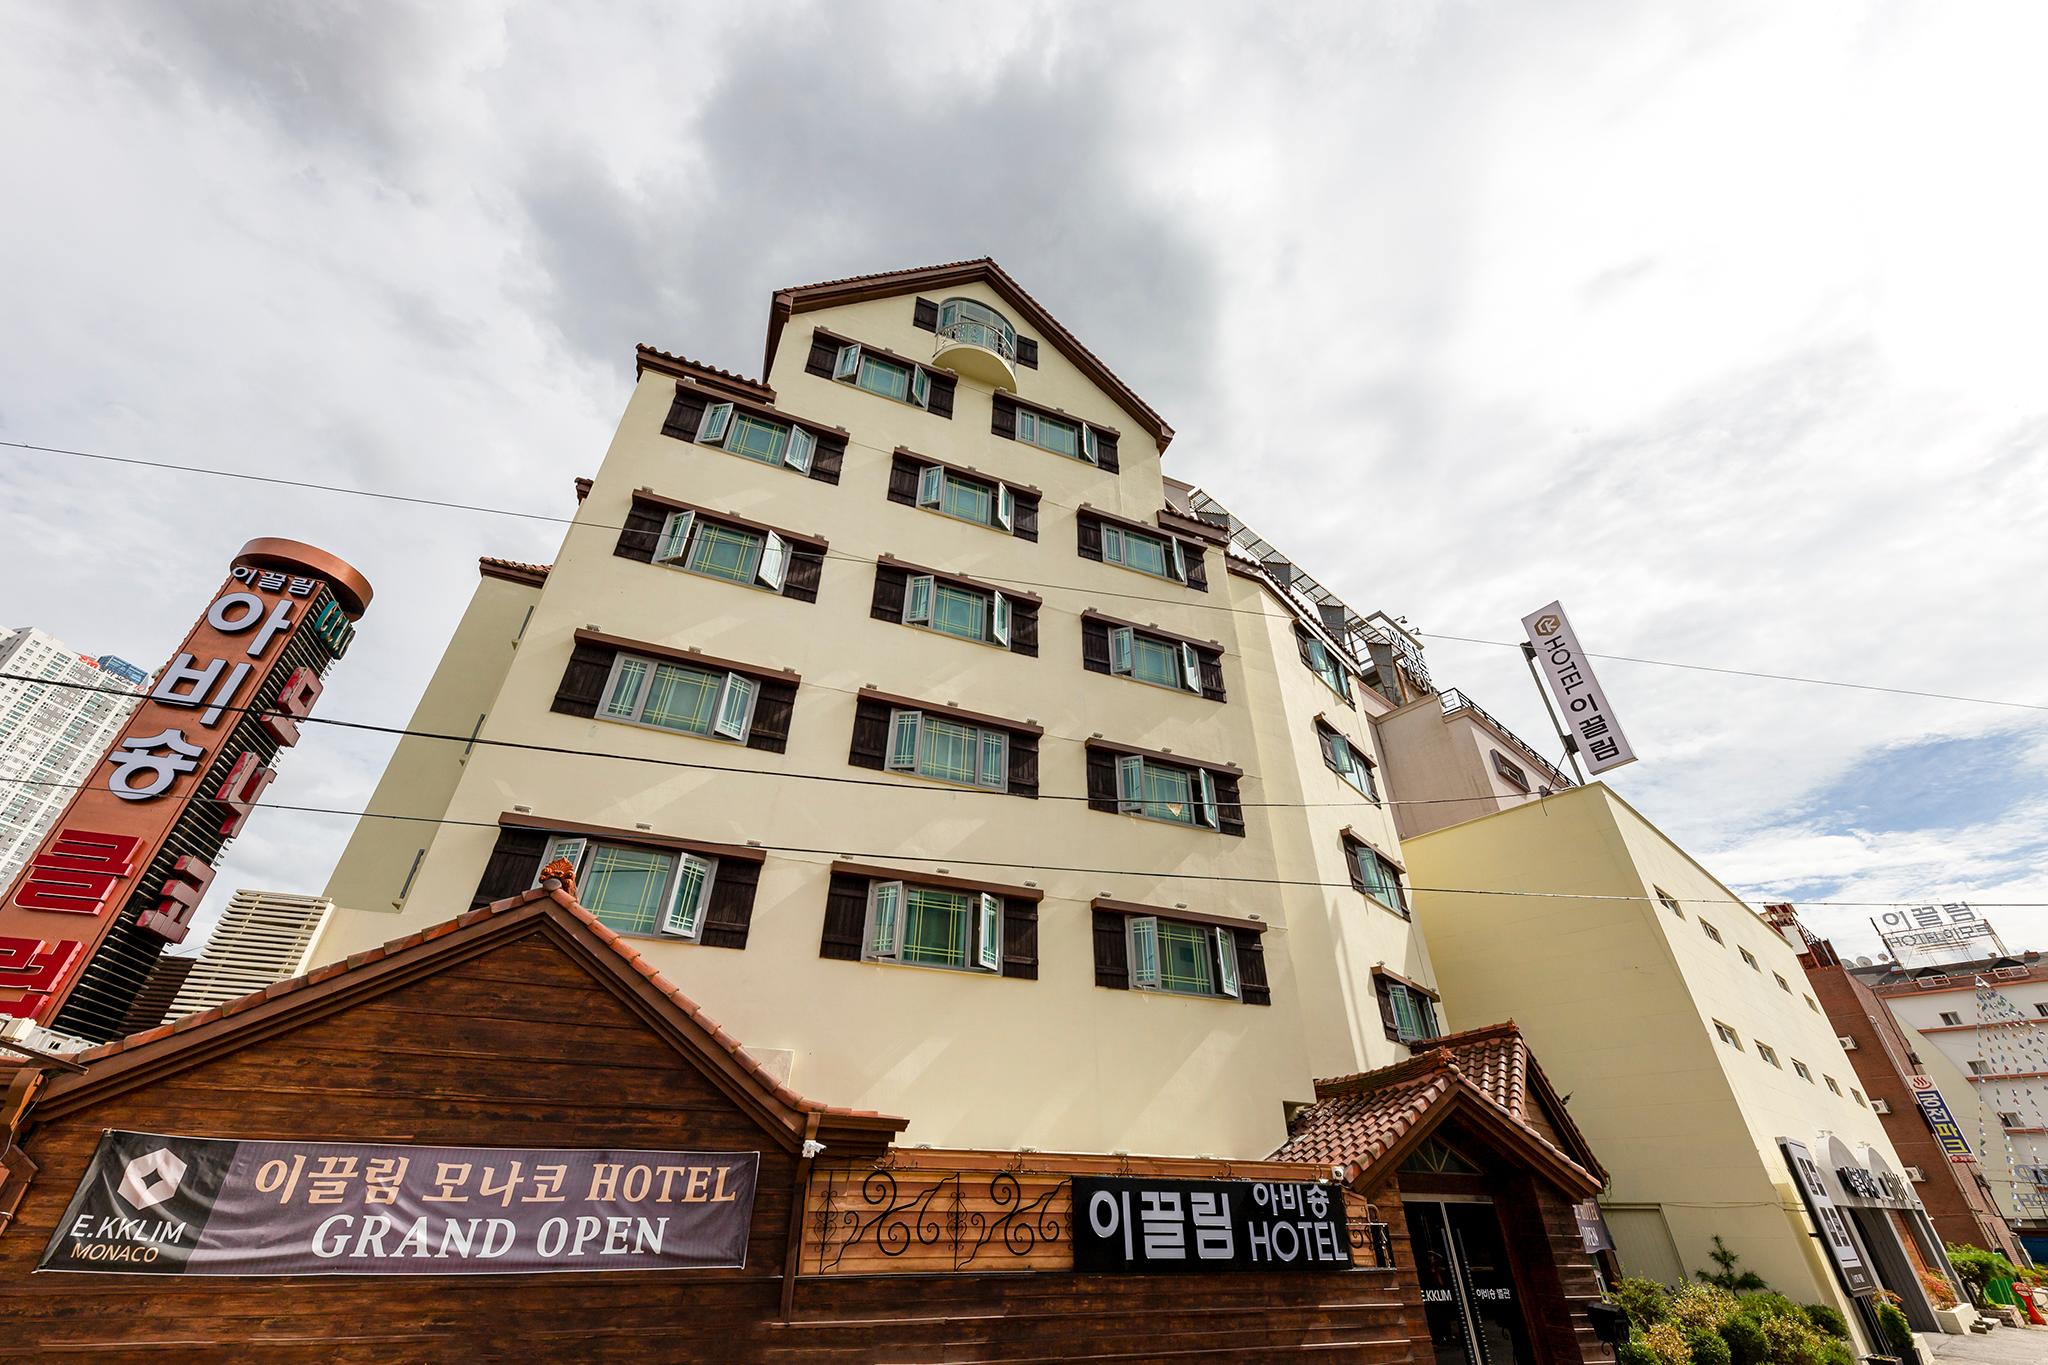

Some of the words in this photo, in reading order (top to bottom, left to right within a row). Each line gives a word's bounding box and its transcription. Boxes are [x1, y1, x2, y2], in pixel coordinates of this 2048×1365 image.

[232, 567, 316, 595] 이끌림
[1544, 635, 1584, 696] HOTEL
[108, 592, 293, 801] 아비숑
[1570, 693, 1620, 762] 이끌림
[1882, 902, 1976, 930] 이끌림
[255, 1154, 410, 1206] 이끌림
[422, 1160, 568, 1208] 모나코
[584, 1163, 737, 1203] HOTEL
[1253, 1183, 1330, 1219] 아비숑
[70, 1214, 187, 1244] E.KKLIM
[311, 1214, 517, 1258] GRAND
[536, 1216, 671, 1258] OPEN
[1089, 1190, 1235, 1262] 이끌림
[1249, 1221, 1350, 1263] HOTEL
[70, 1243, 159, 1264] MONACO
